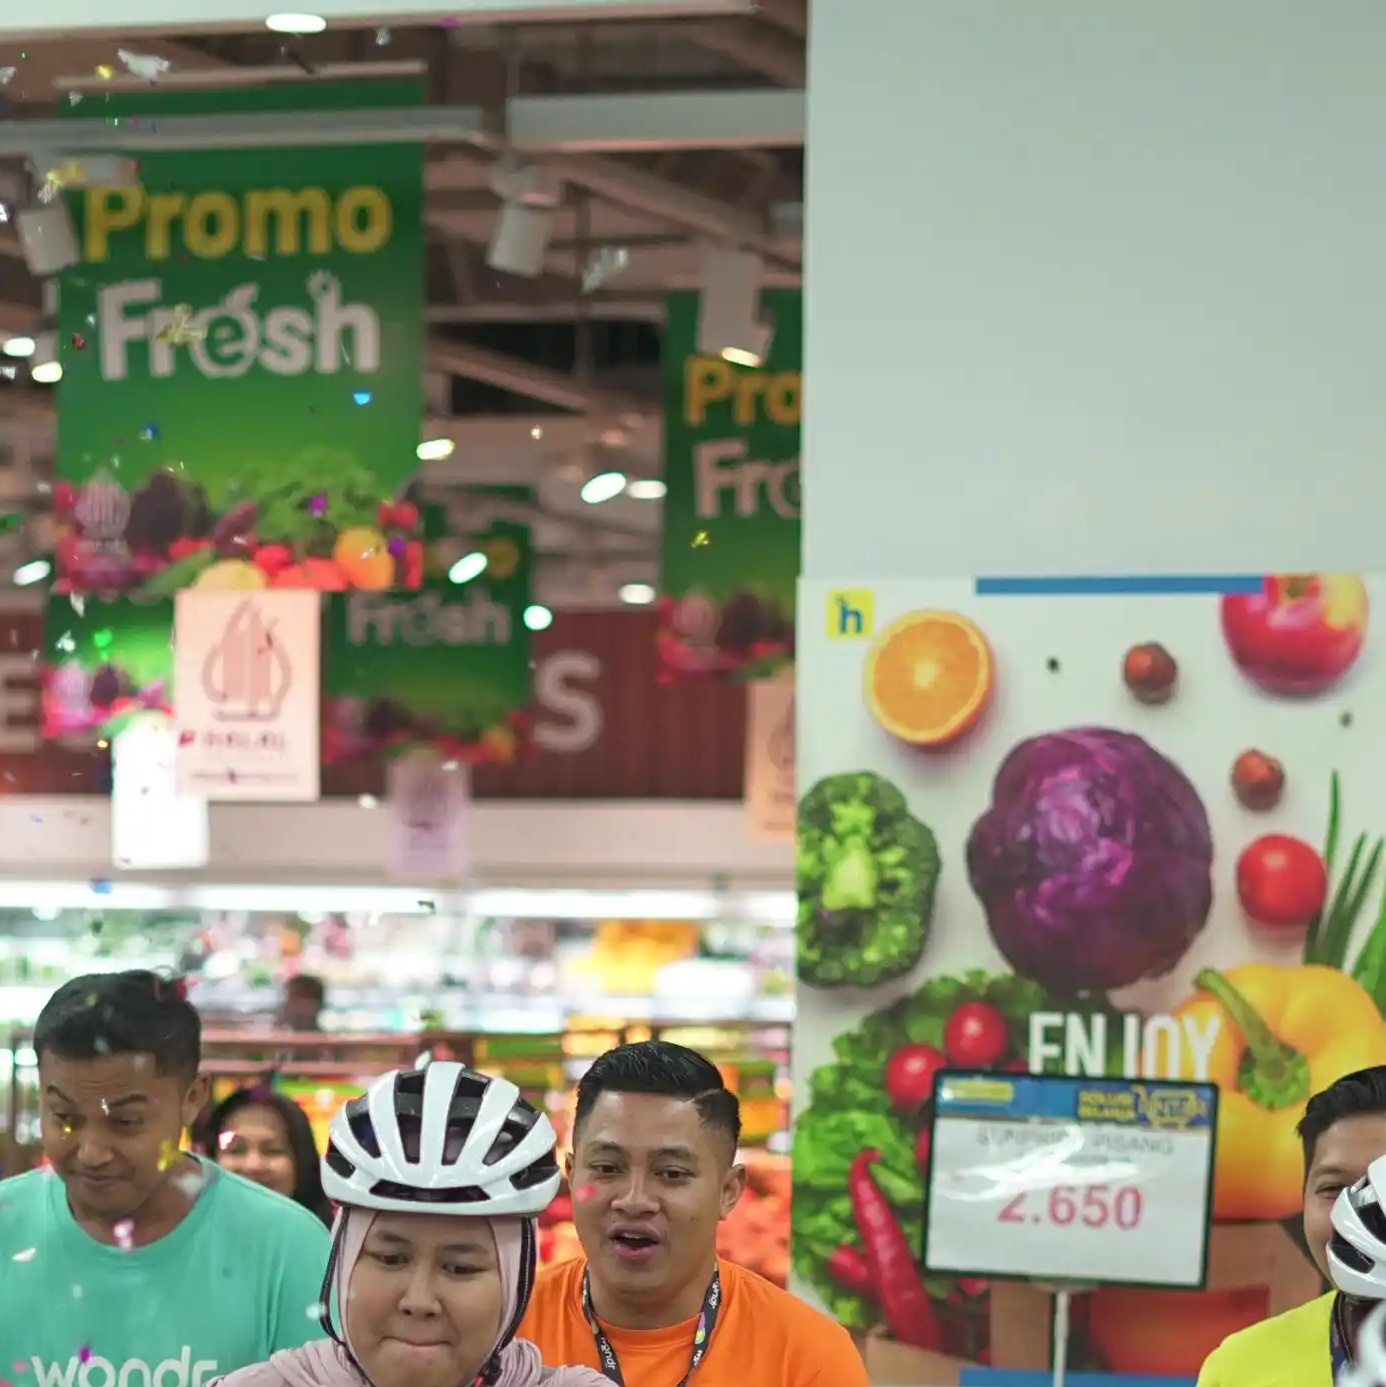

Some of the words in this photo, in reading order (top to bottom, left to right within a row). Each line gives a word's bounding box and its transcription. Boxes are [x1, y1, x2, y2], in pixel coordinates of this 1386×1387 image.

[86, 184, 393, 261] Promo
[98, 271, 381, 380] Fresh
[686, 356, 802, 425] Pro
